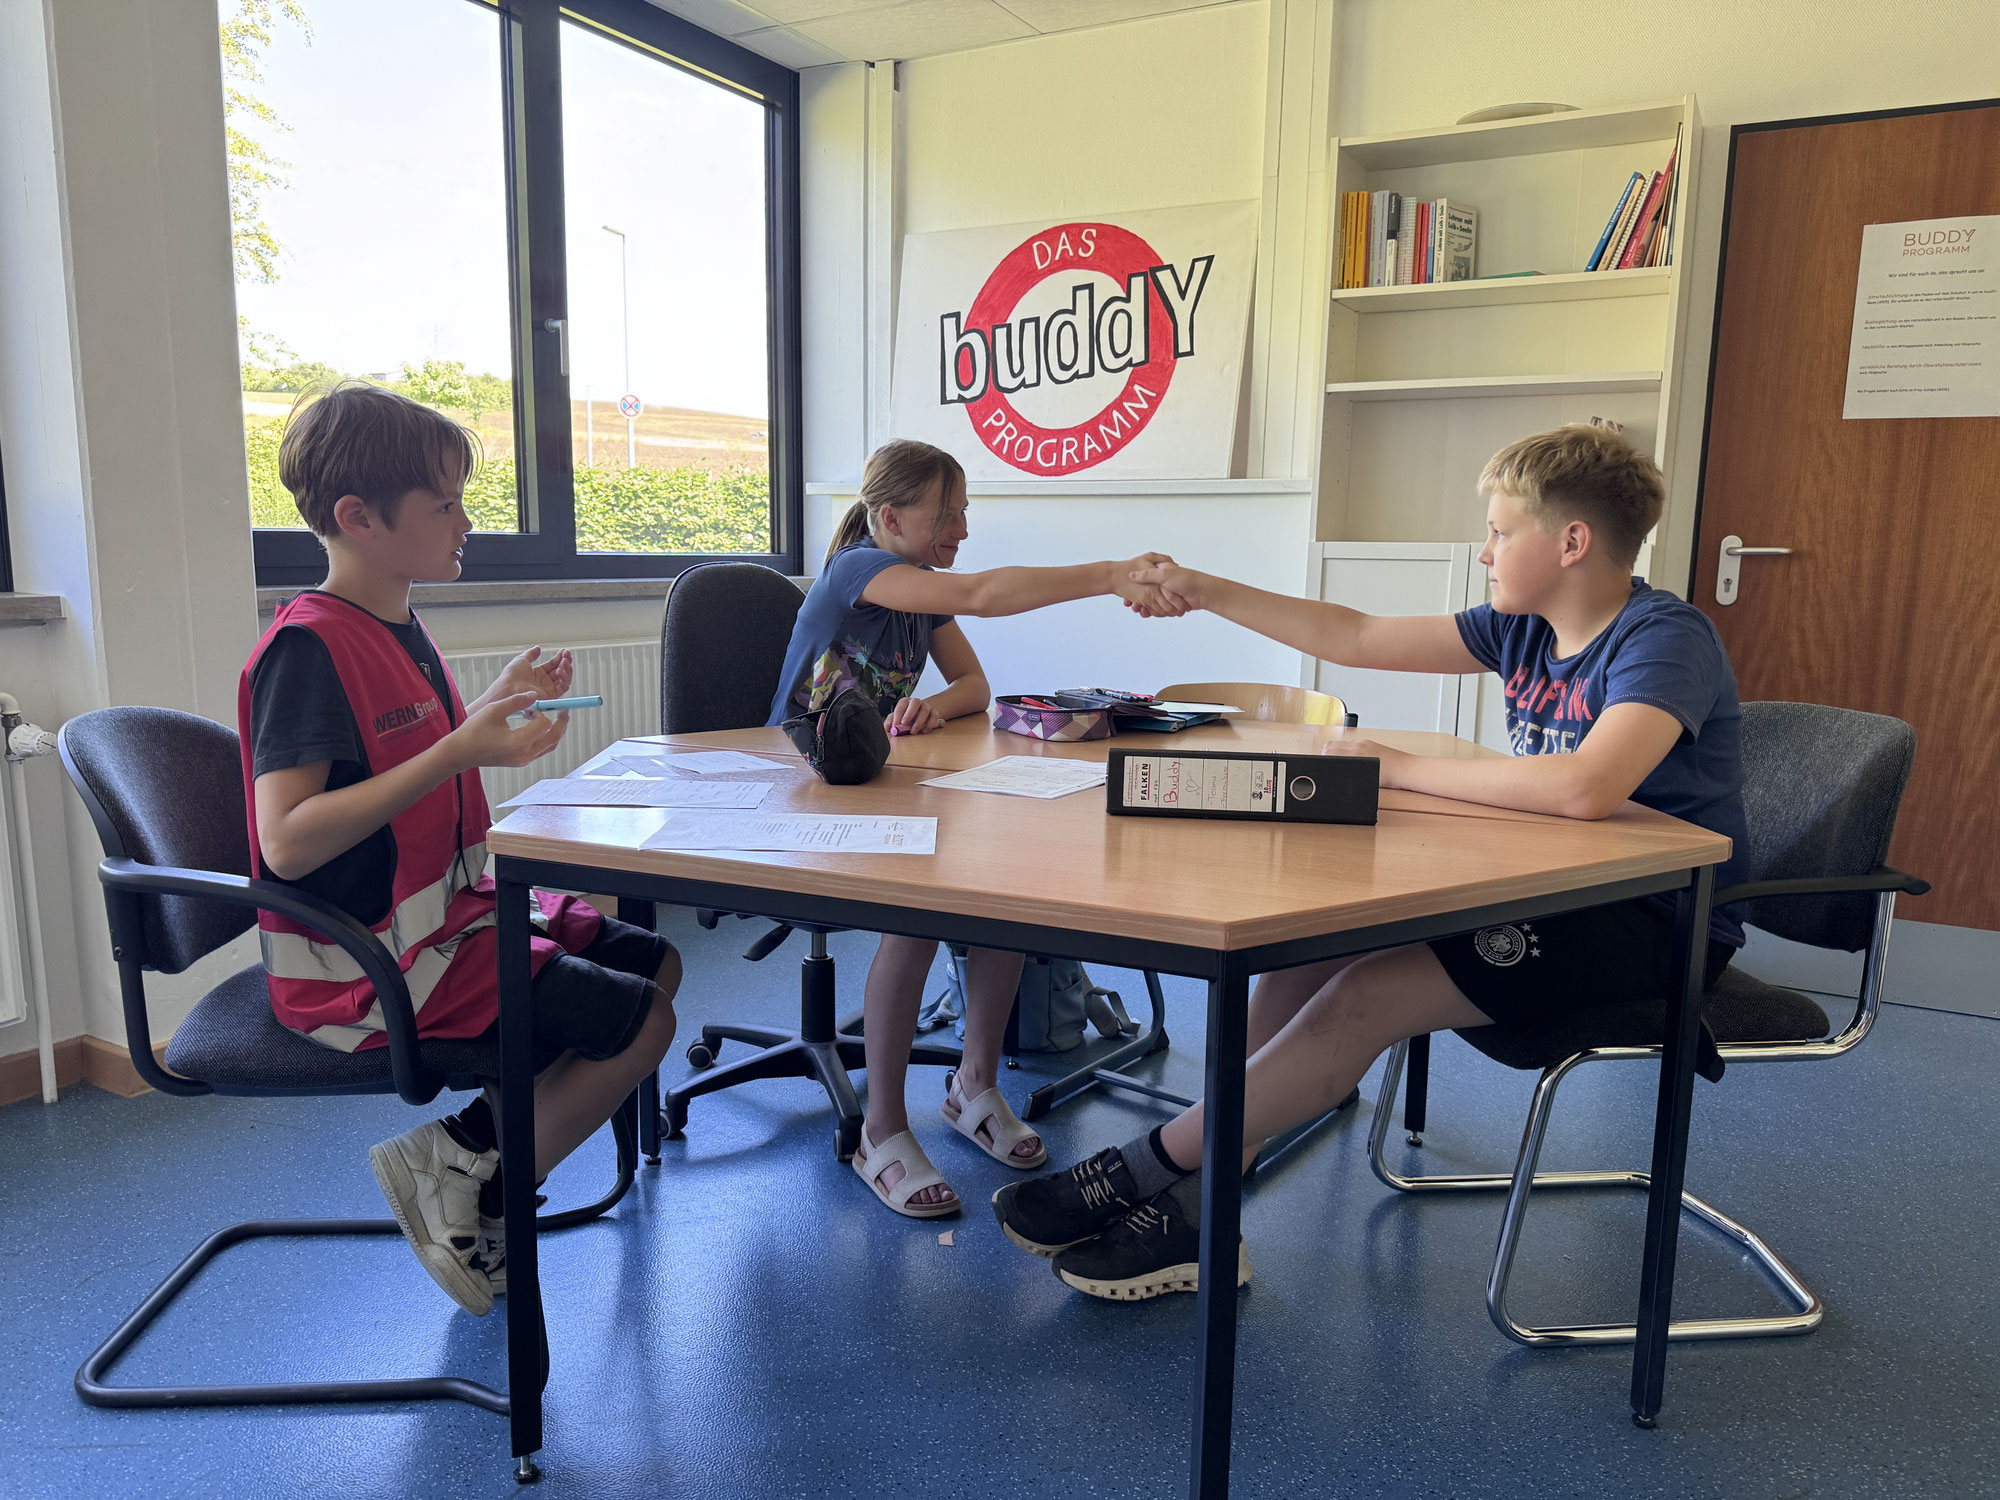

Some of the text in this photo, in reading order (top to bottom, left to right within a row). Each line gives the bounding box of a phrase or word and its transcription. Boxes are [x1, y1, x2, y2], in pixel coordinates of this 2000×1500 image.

[1032, 228, 1097, 270] DAS
[1902, 246, 1970, 256] PROGRAMM
[1904, 228, 1976, 246] BUDDY
[940, 254, 1215, 405] buddY
[982, 383, 1157, 468] PROGRAMM
[1140, 762, 1149, 801] FALKEN
[1162, 761, 1183, 804] Buddy
